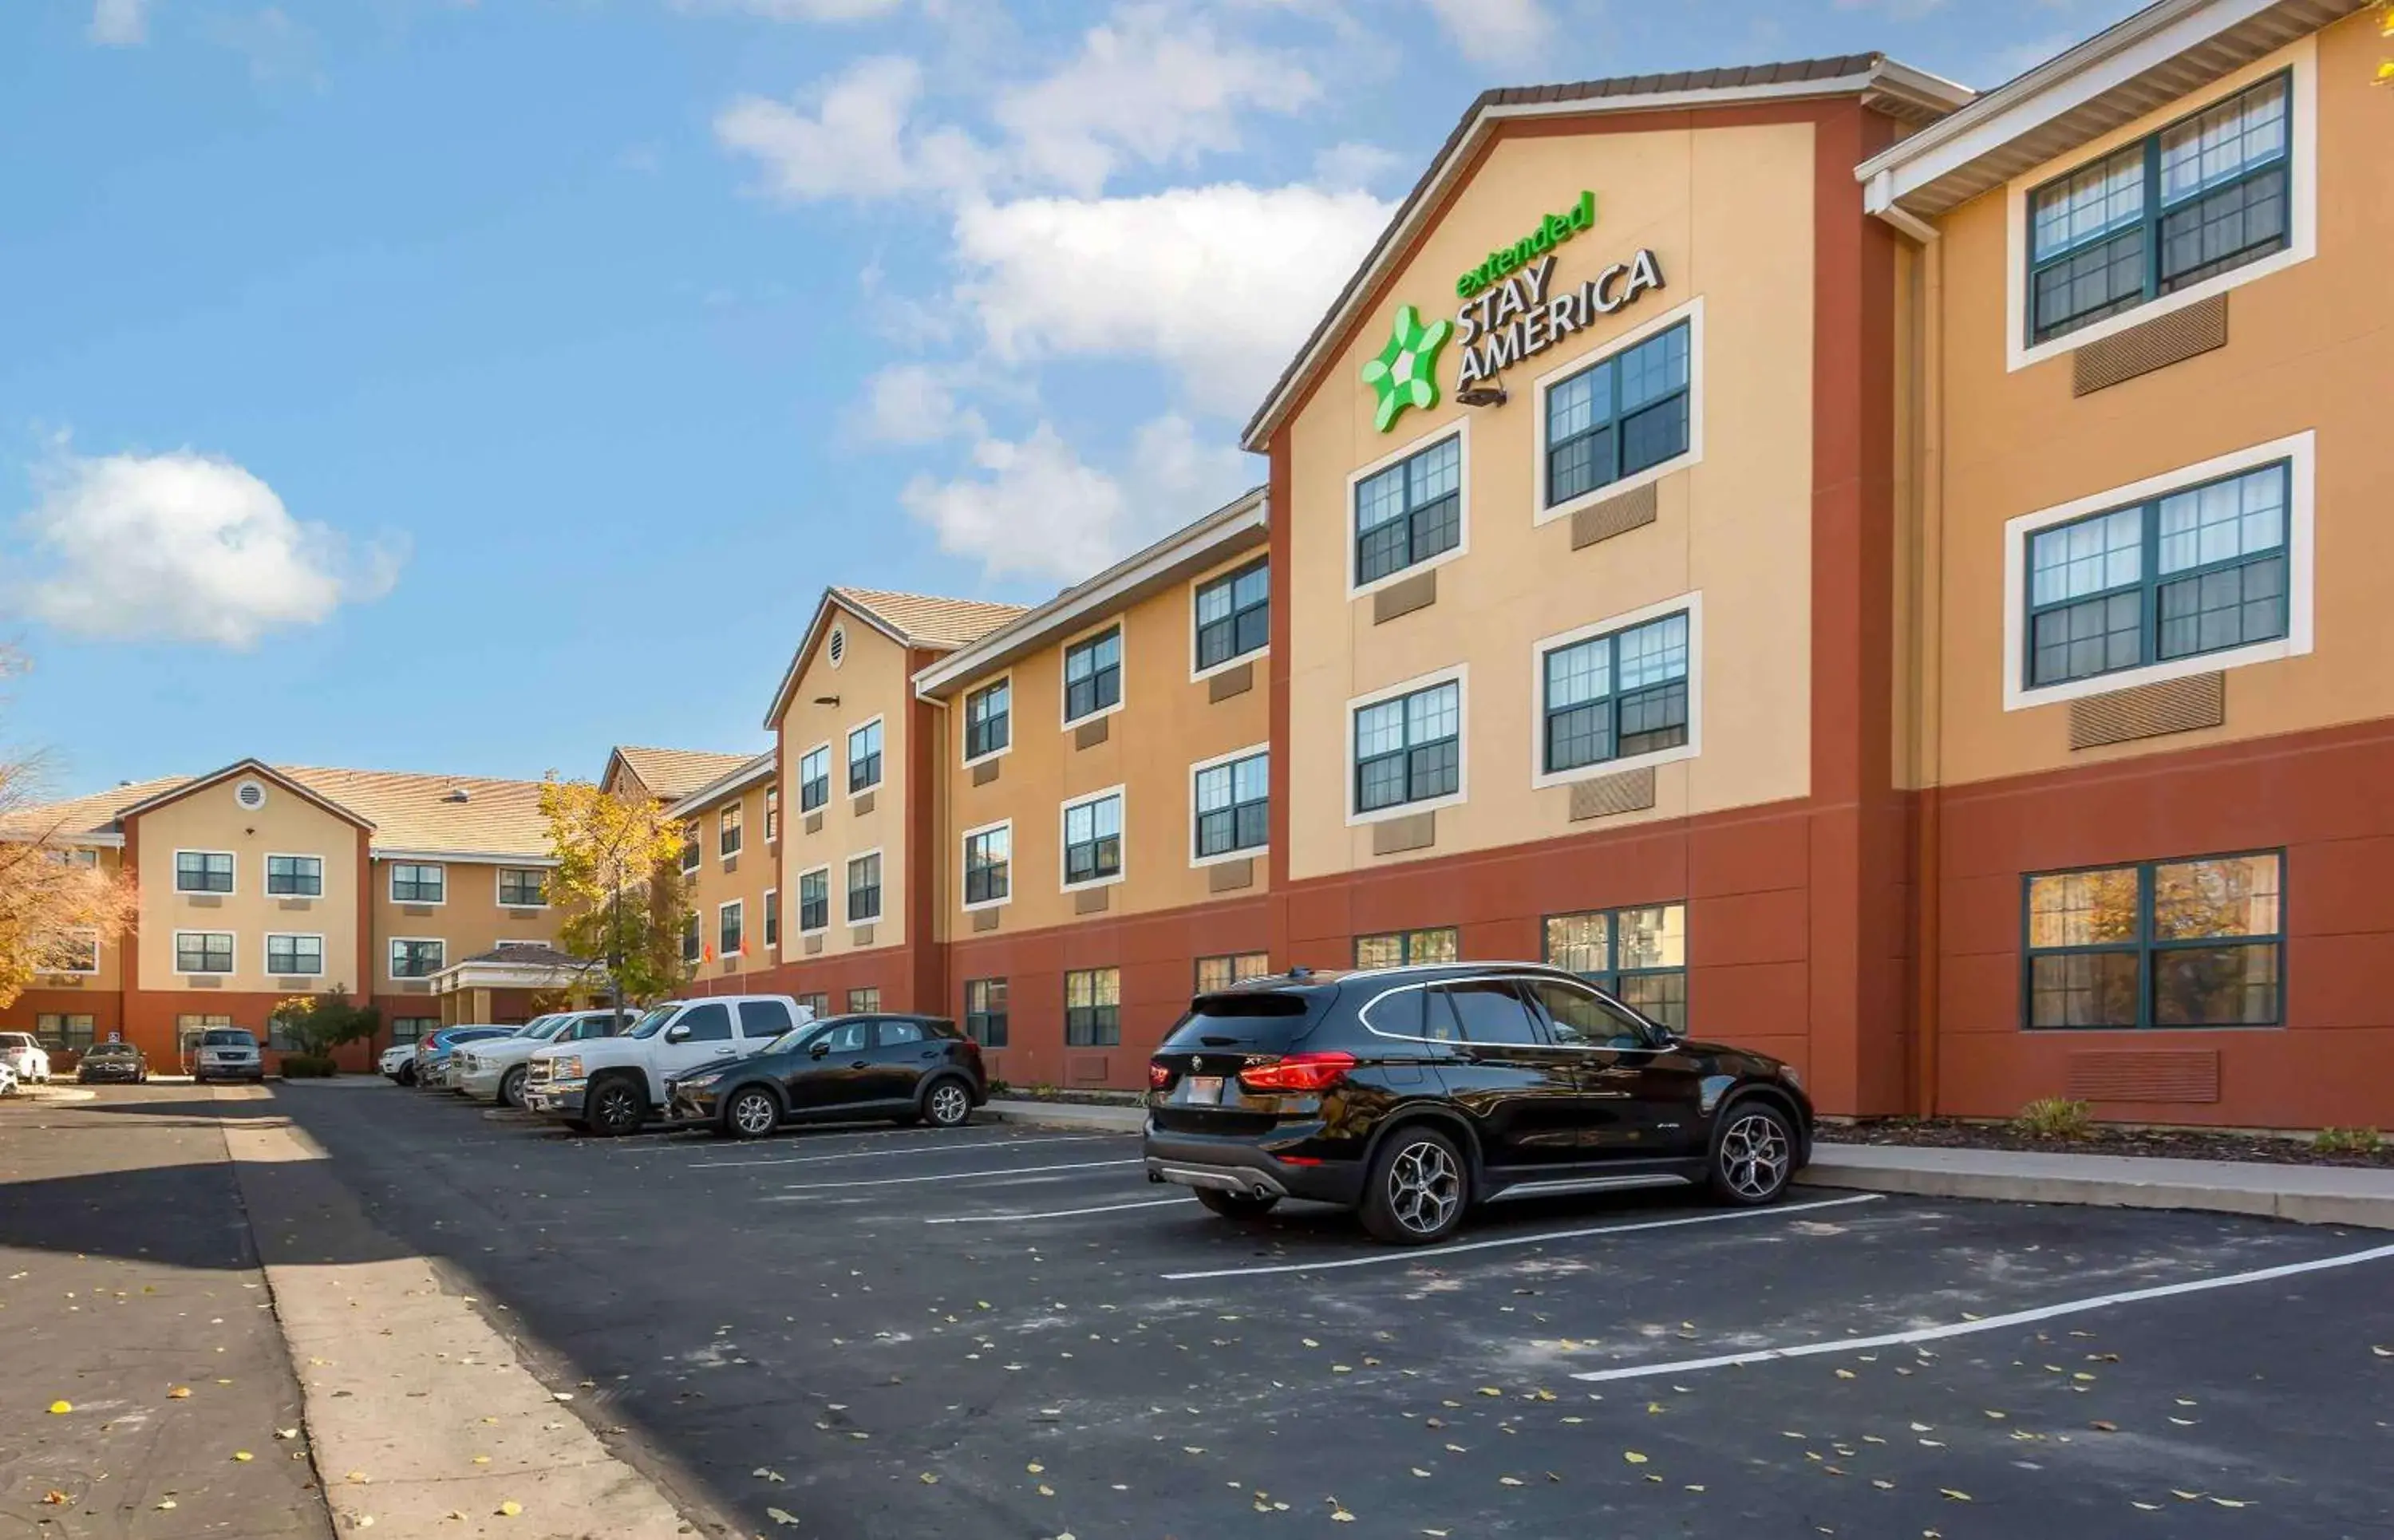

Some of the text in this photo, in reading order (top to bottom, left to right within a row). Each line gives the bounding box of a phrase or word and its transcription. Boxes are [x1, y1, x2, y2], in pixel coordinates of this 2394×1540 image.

[1456, 190, 1595, 298] extended
[1456, 255, 1558, 346] STAY
[1456, 248, 1666, 392] AMERICA
